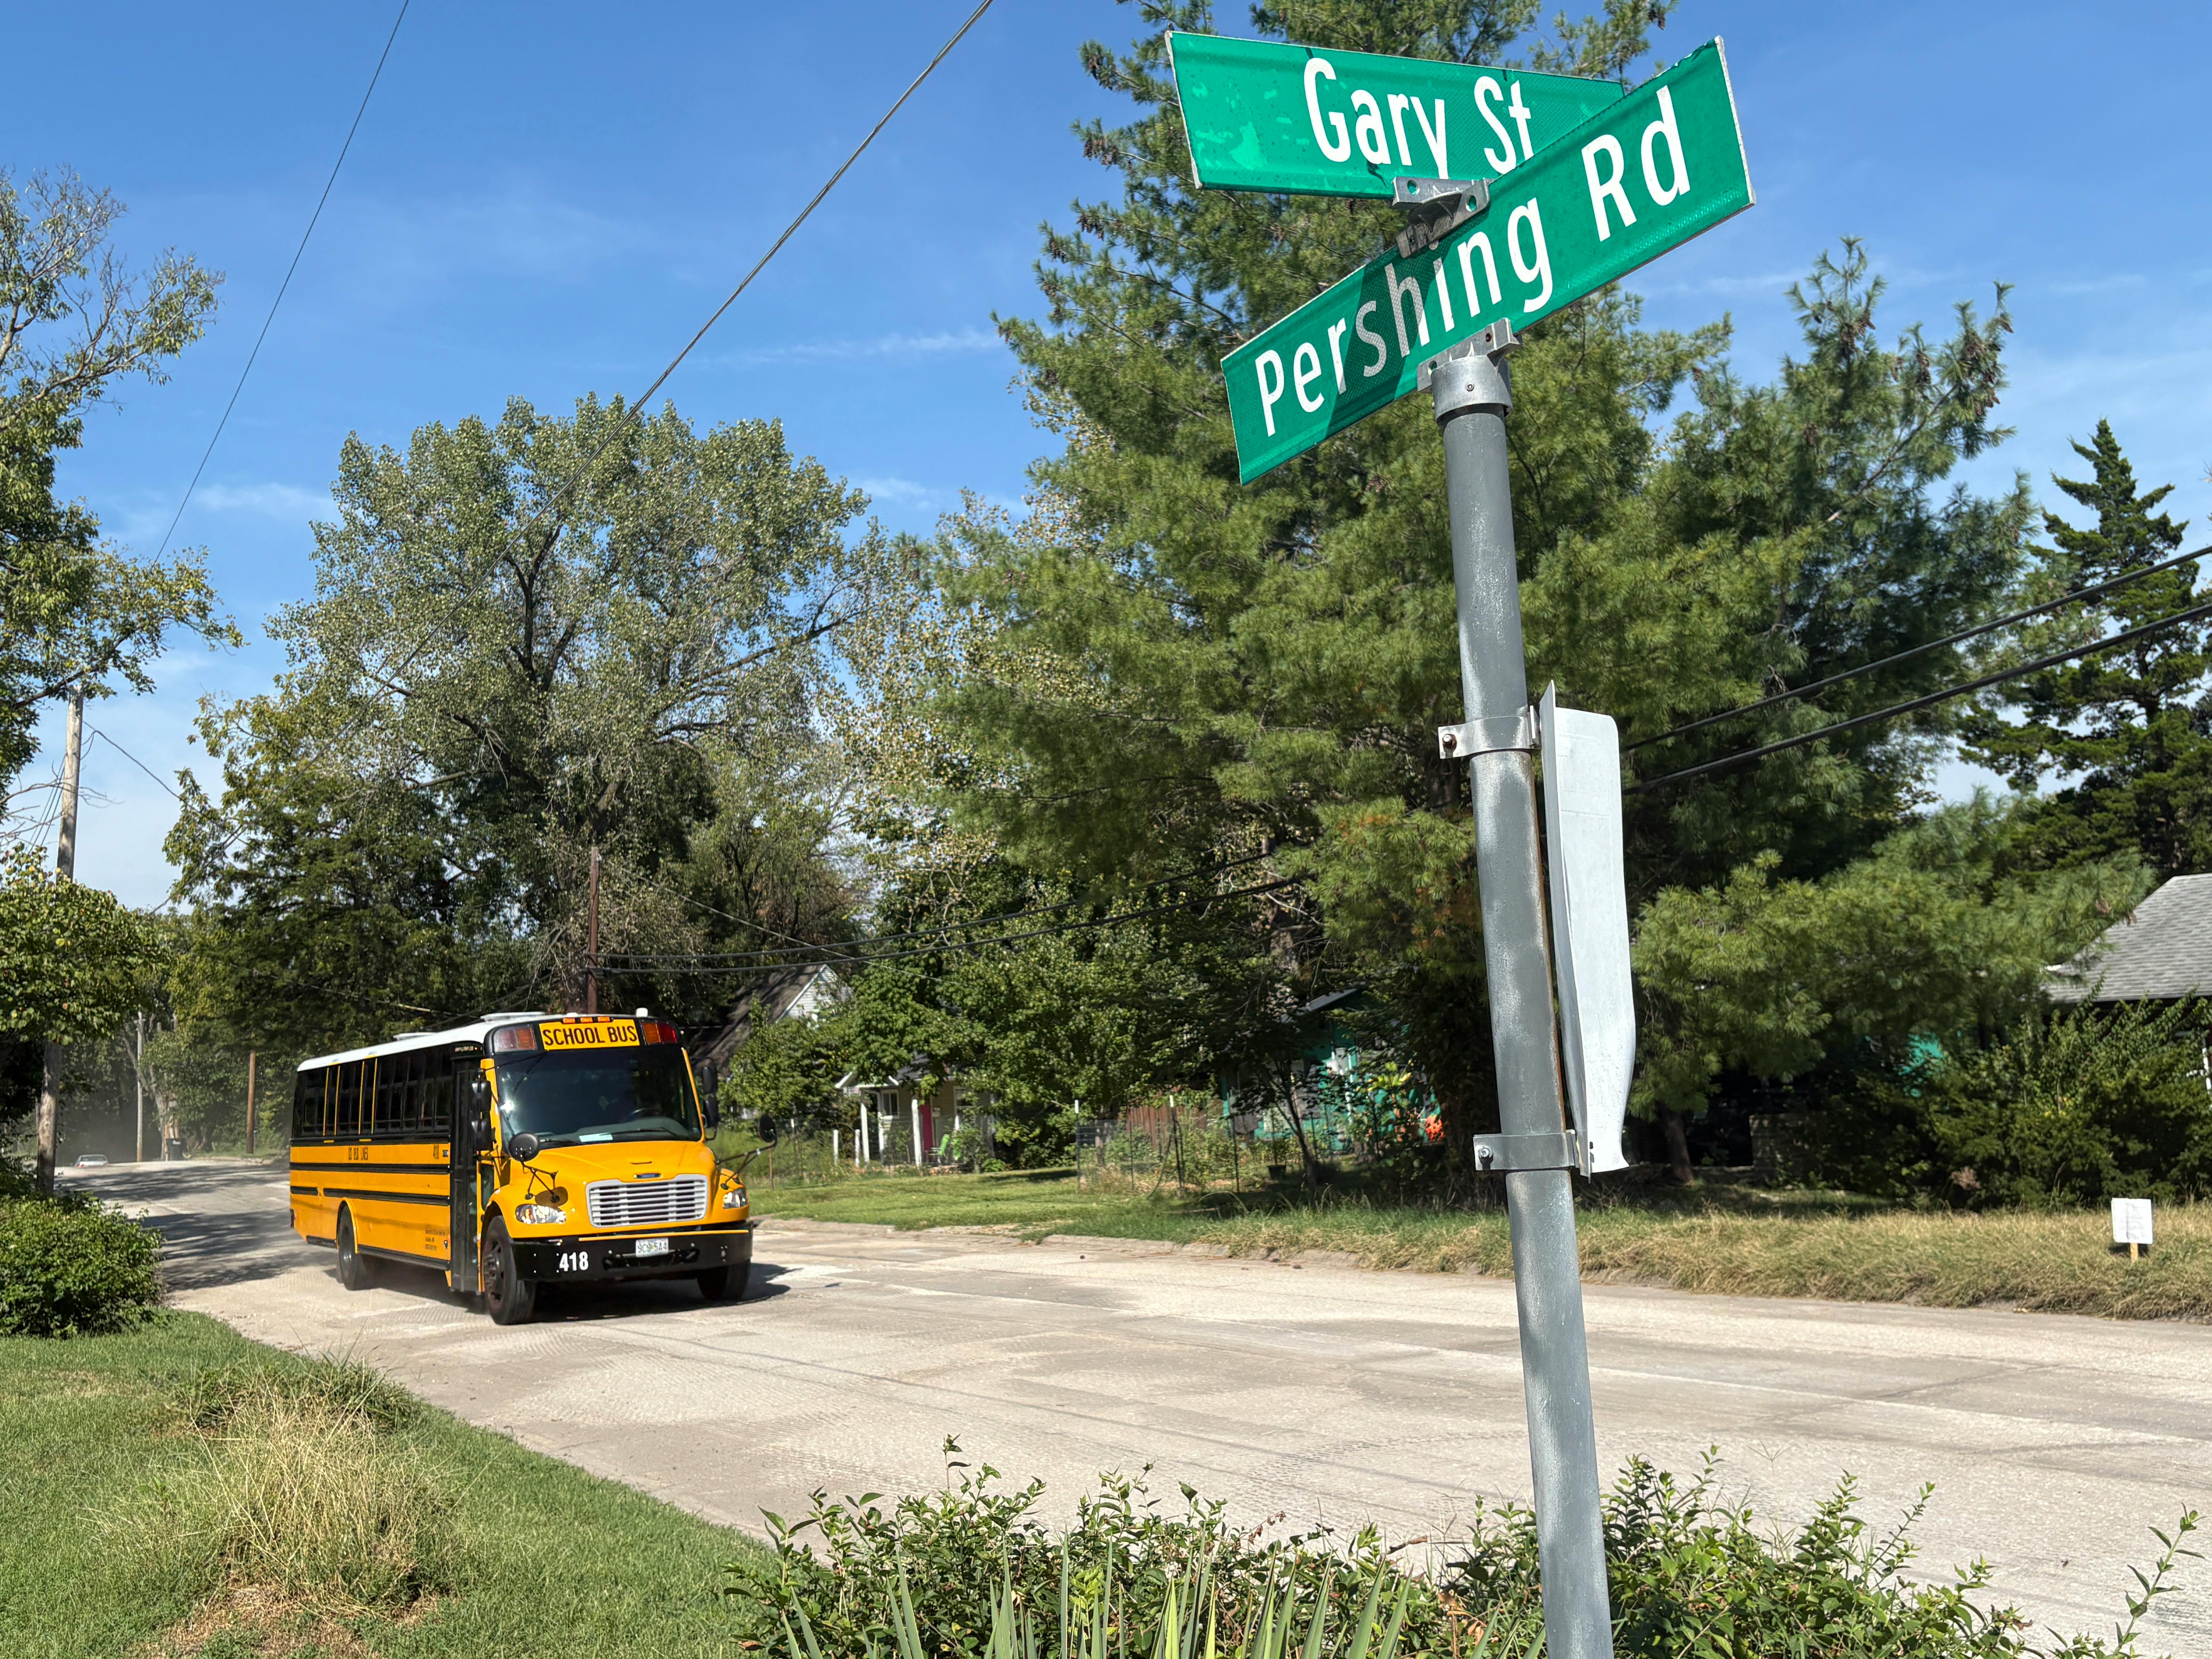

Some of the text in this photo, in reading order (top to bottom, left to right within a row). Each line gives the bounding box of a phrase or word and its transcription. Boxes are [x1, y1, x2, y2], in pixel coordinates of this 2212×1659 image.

[1304, 57, 1532, 179] Gary St
[1255, 85, 1690, 437] Pershing Rd
[542, 1025, 637, 1046] SCHOOL BUS
[559, 1251, 589, 1272] 418
